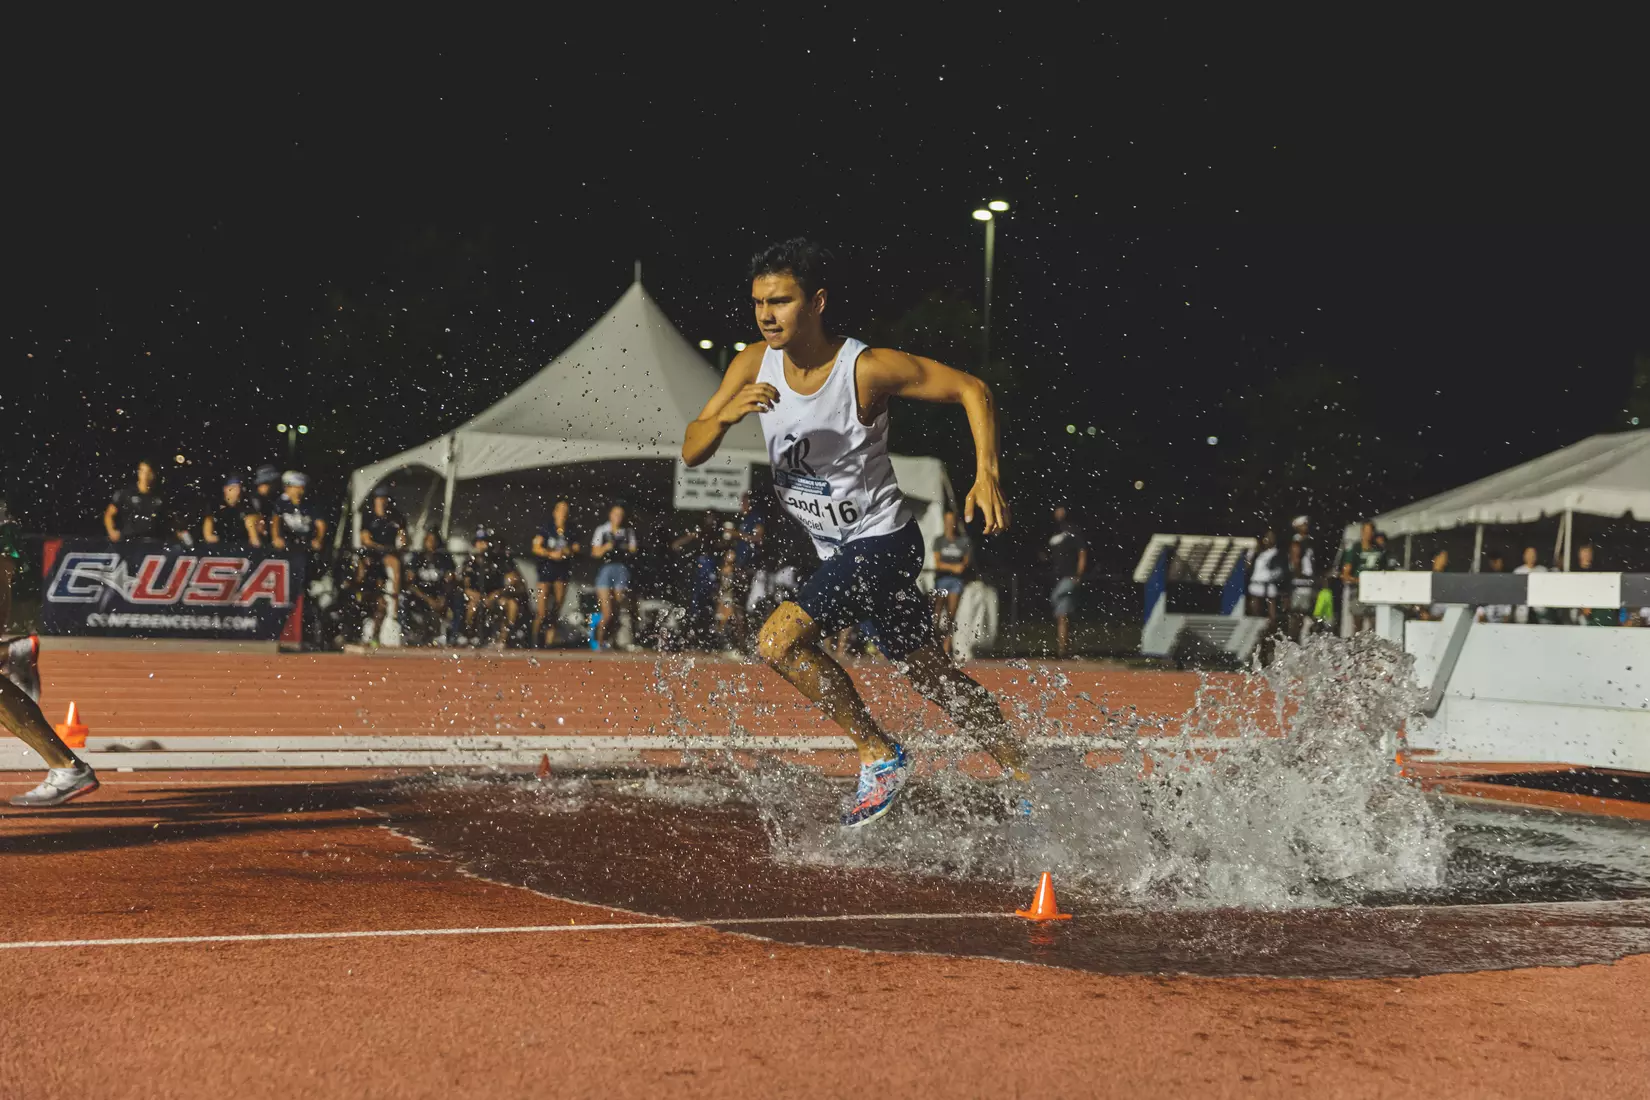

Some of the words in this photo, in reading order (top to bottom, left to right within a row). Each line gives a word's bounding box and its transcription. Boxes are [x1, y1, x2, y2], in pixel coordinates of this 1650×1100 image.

[777, 490, 824, 517] Land
[824, 500, 858, 526] 16
[87, 612, 257, 630] CONFERENCEUSA.COM
